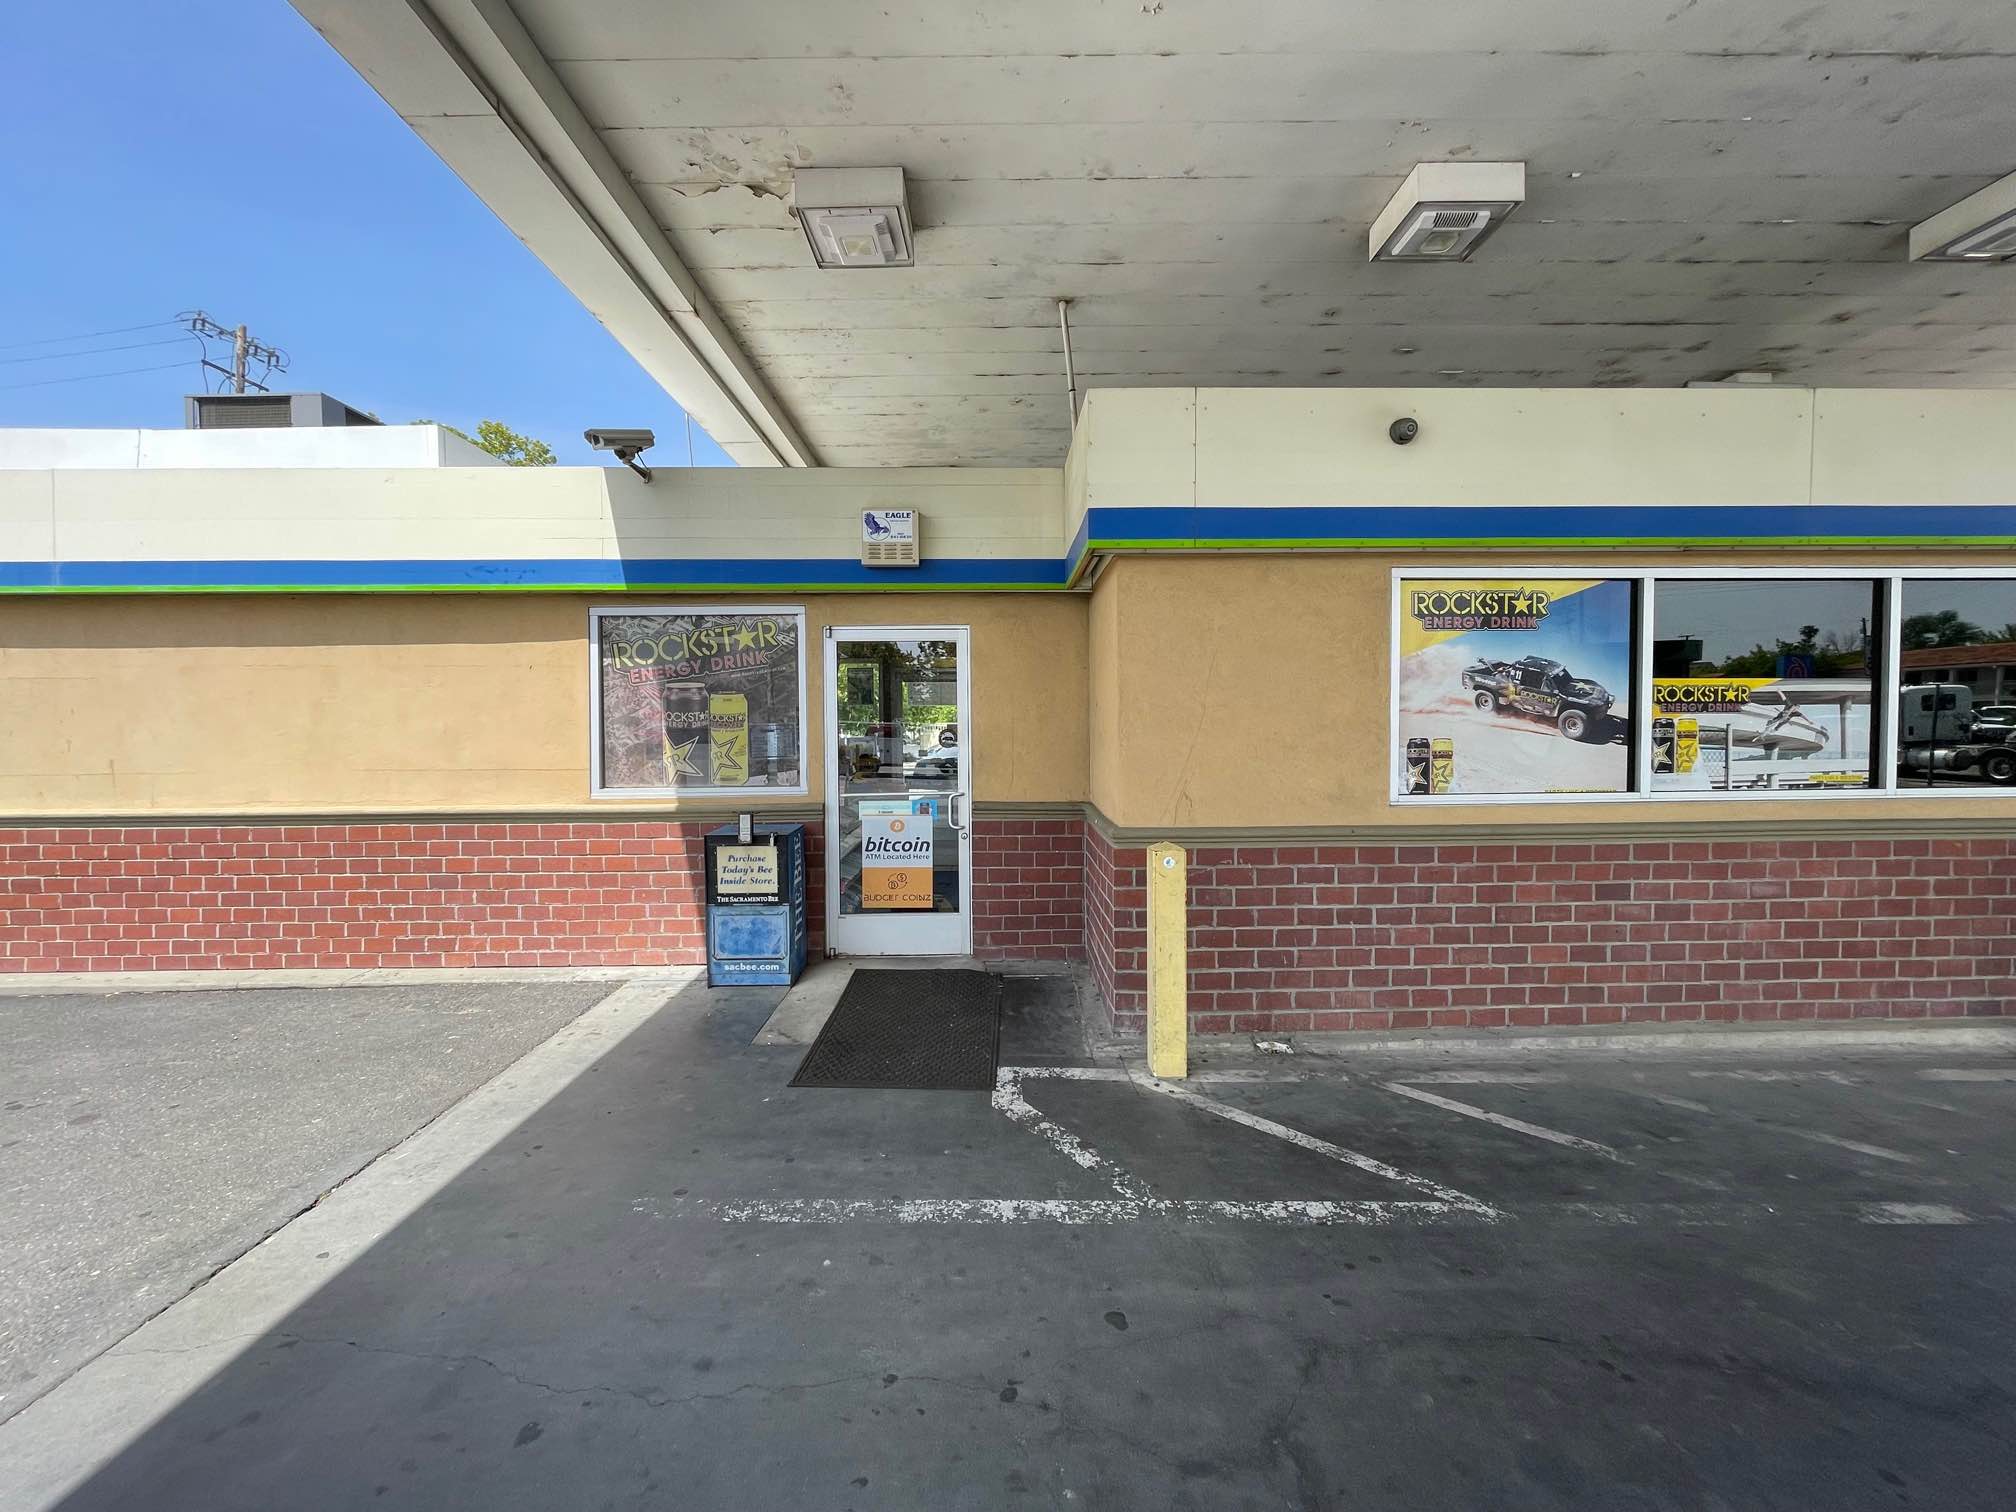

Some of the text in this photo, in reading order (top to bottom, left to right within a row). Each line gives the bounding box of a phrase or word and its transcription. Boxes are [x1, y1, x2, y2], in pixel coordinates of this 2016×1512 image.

[1424, 616, 1538, 629] ENERGY DRINK
[629, 651, 768, 683] ENERGY DRINK
[1661, 702, 1743, 712] ENERGY DRINK
[864, 836, 931, 853] bitcoin
[727, 854, 766, 863] Purchase
[721, 865, 754, 876] Today's
[720, 876, 776, 885] Inside Store.
[864, 894, 931, 902] BUDGET COINZ
[724, 961, 780, 971] sacbee.com
